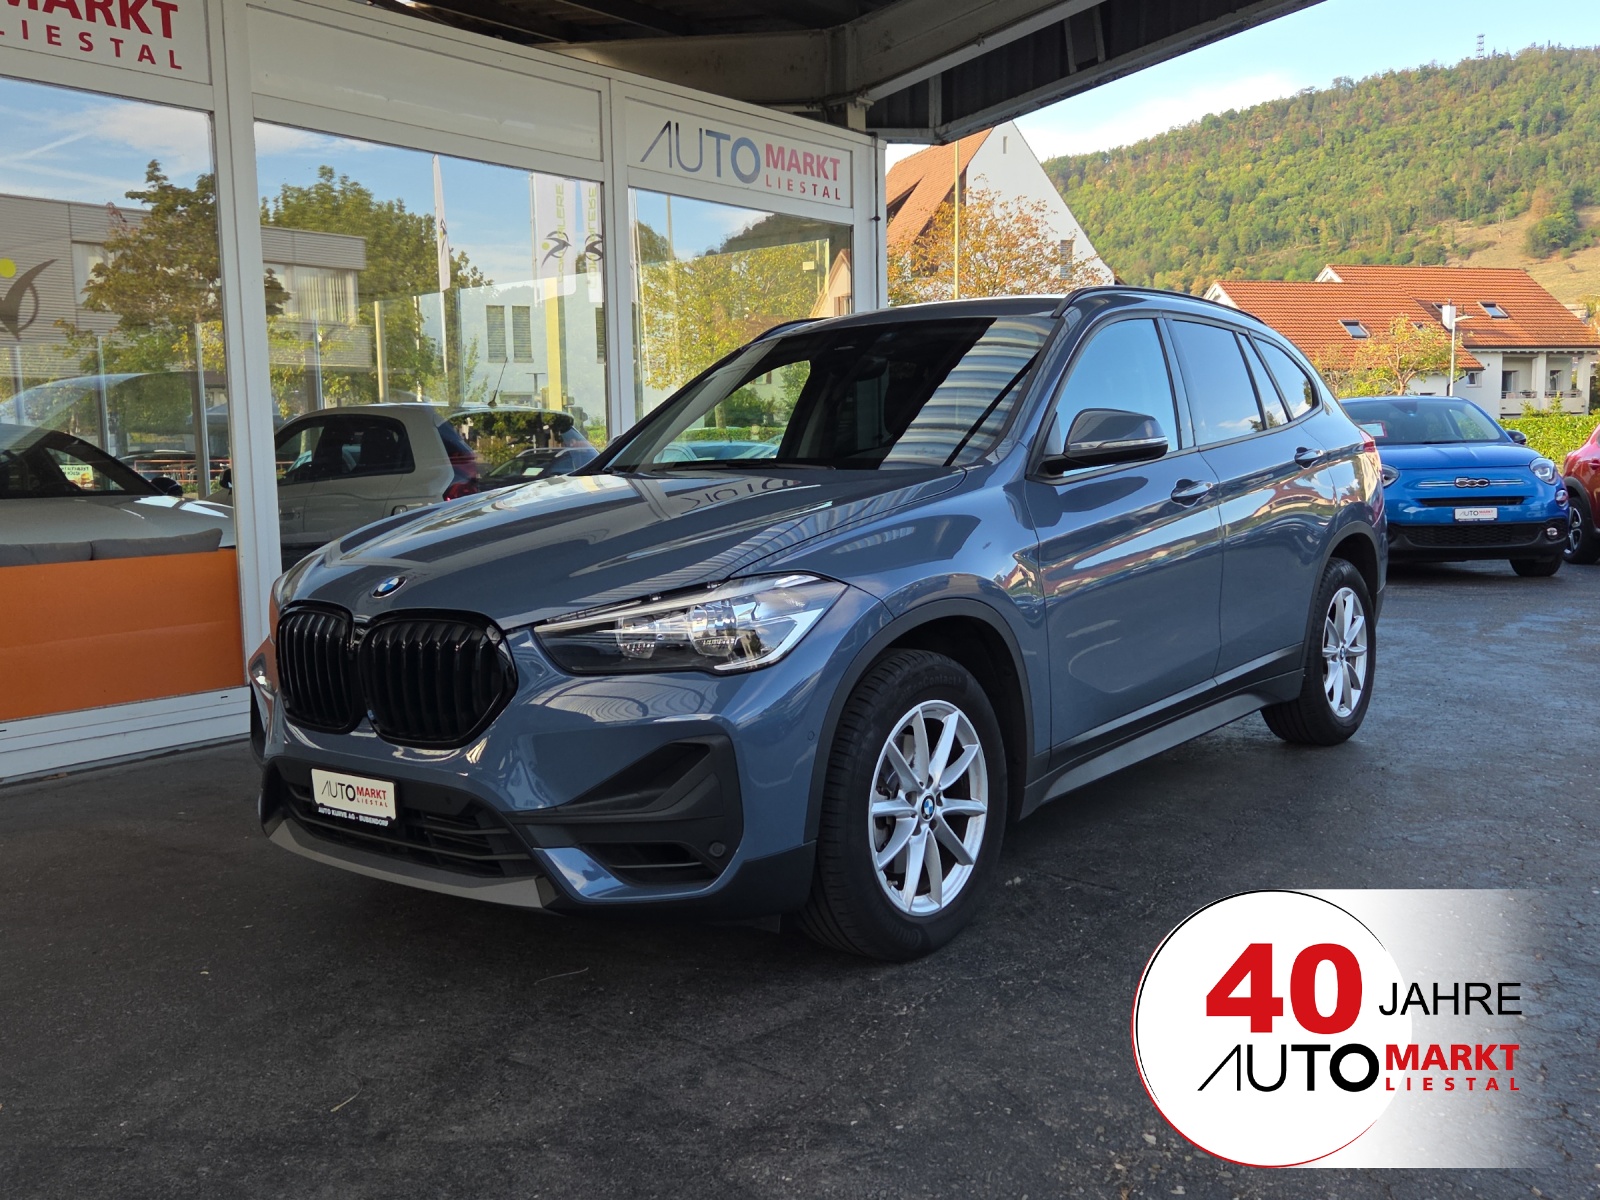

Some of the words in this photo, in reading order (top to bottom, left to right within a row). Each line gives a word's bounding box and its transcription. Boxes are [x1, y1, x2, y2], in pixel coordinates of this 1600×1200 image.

[6, 0, 178, 39] RKT
[0, 19, 183, 70] IESTAL
[640, 120, 761, 184] AUTO
[765, 143, 841, 181] MARKT
[766, 174, 841, 200] LIESTAL
[1455, 477, 1490, 488] 500
[321, 780, 355, 801] AUTO
[356, 786, 387, 800] MARKT
[356, 797, 388, 807] LIESTAL
